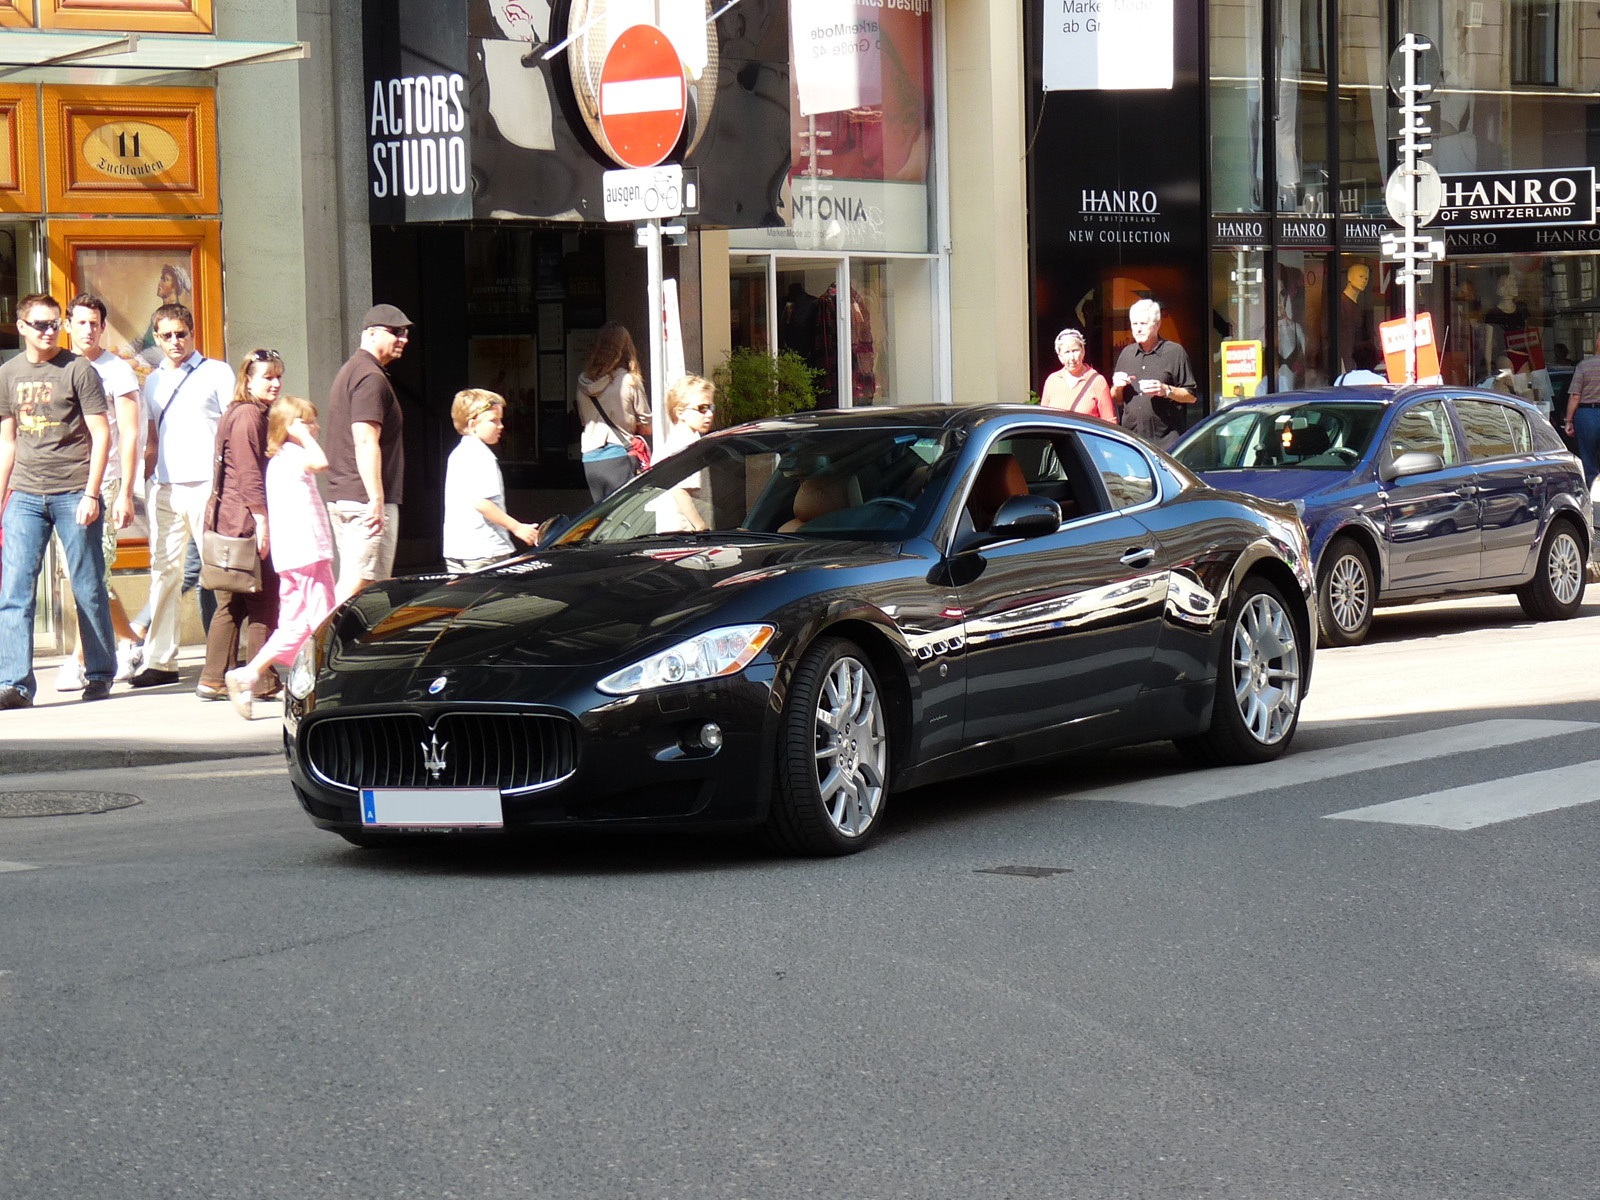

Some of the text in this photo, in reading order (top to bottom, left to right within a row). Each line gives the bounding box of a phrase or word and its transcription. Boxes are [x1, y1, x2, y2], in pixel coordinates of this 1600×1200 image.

[1062, 19, 1080, 33] ab
[371, 73, 464, 136] ACTORS
[117, 130, 141, 157] 11
[96, 157, 164, 175] Tuchlauben
[373, 136, 466, 197] STUDIO
[606, 185, 644, 207] ausgen.
[1440, 177, 1577, 207] HANRO
[792, 195, 867, 222] NTONIA
[1082, 189, 1157, 213] HANRO
[1099, 215, 1156, 223] SWITZERLAND
[1440, 206, 1572, 221] OF SWITZERLAND
[1069, 230, 1171, 243] NEW COLLECTION
[1217, 222, 1262, 237] HANRO
[1283, 223, 1326, 237] HANRO
[1536, 228, 1600, 243] HANRO
[1445, 232, 1497, 246] ANRO
[368, 810, 375, 819] A
